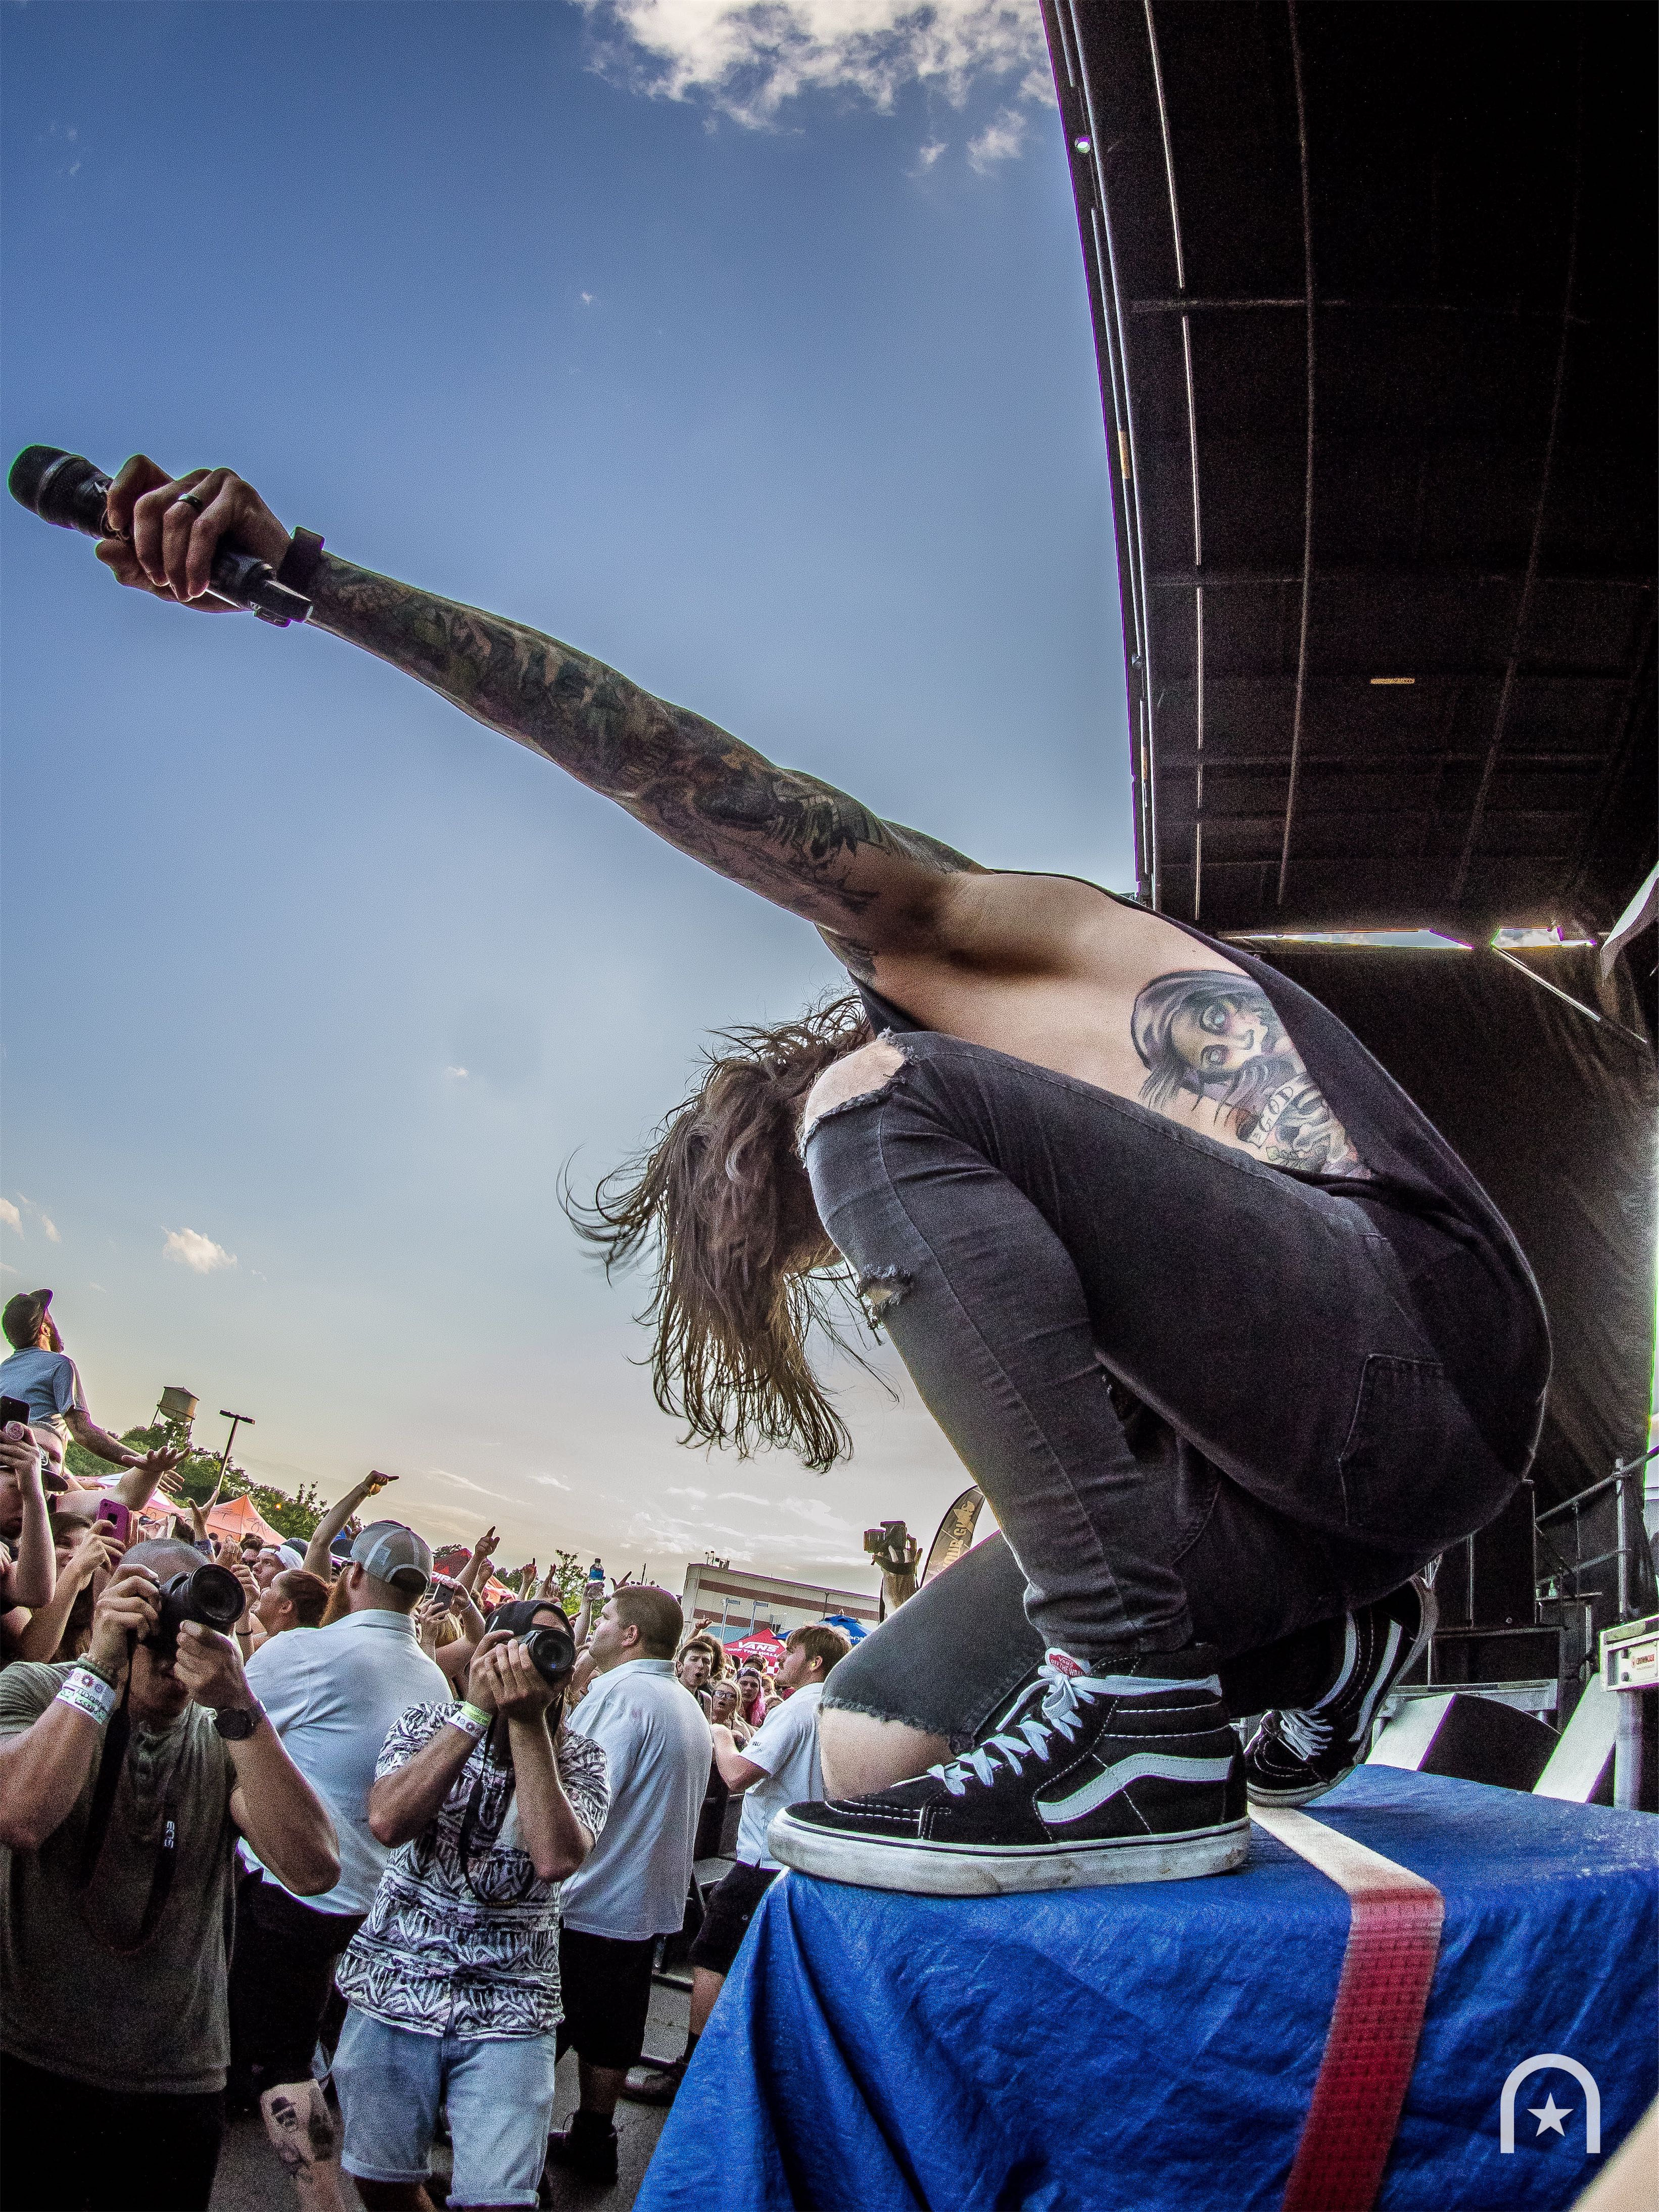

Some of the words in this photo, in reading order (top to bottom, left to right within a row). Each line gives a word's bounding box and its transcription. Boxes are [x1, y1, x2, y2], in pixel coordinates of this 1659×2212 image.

[942, 1539, 964, 1567] OUR
[738, 1641, 779, 1653] VANS
[1058, 1656, 1073, 1668] VANS
[164, 1820, 175, 1849] EOS
